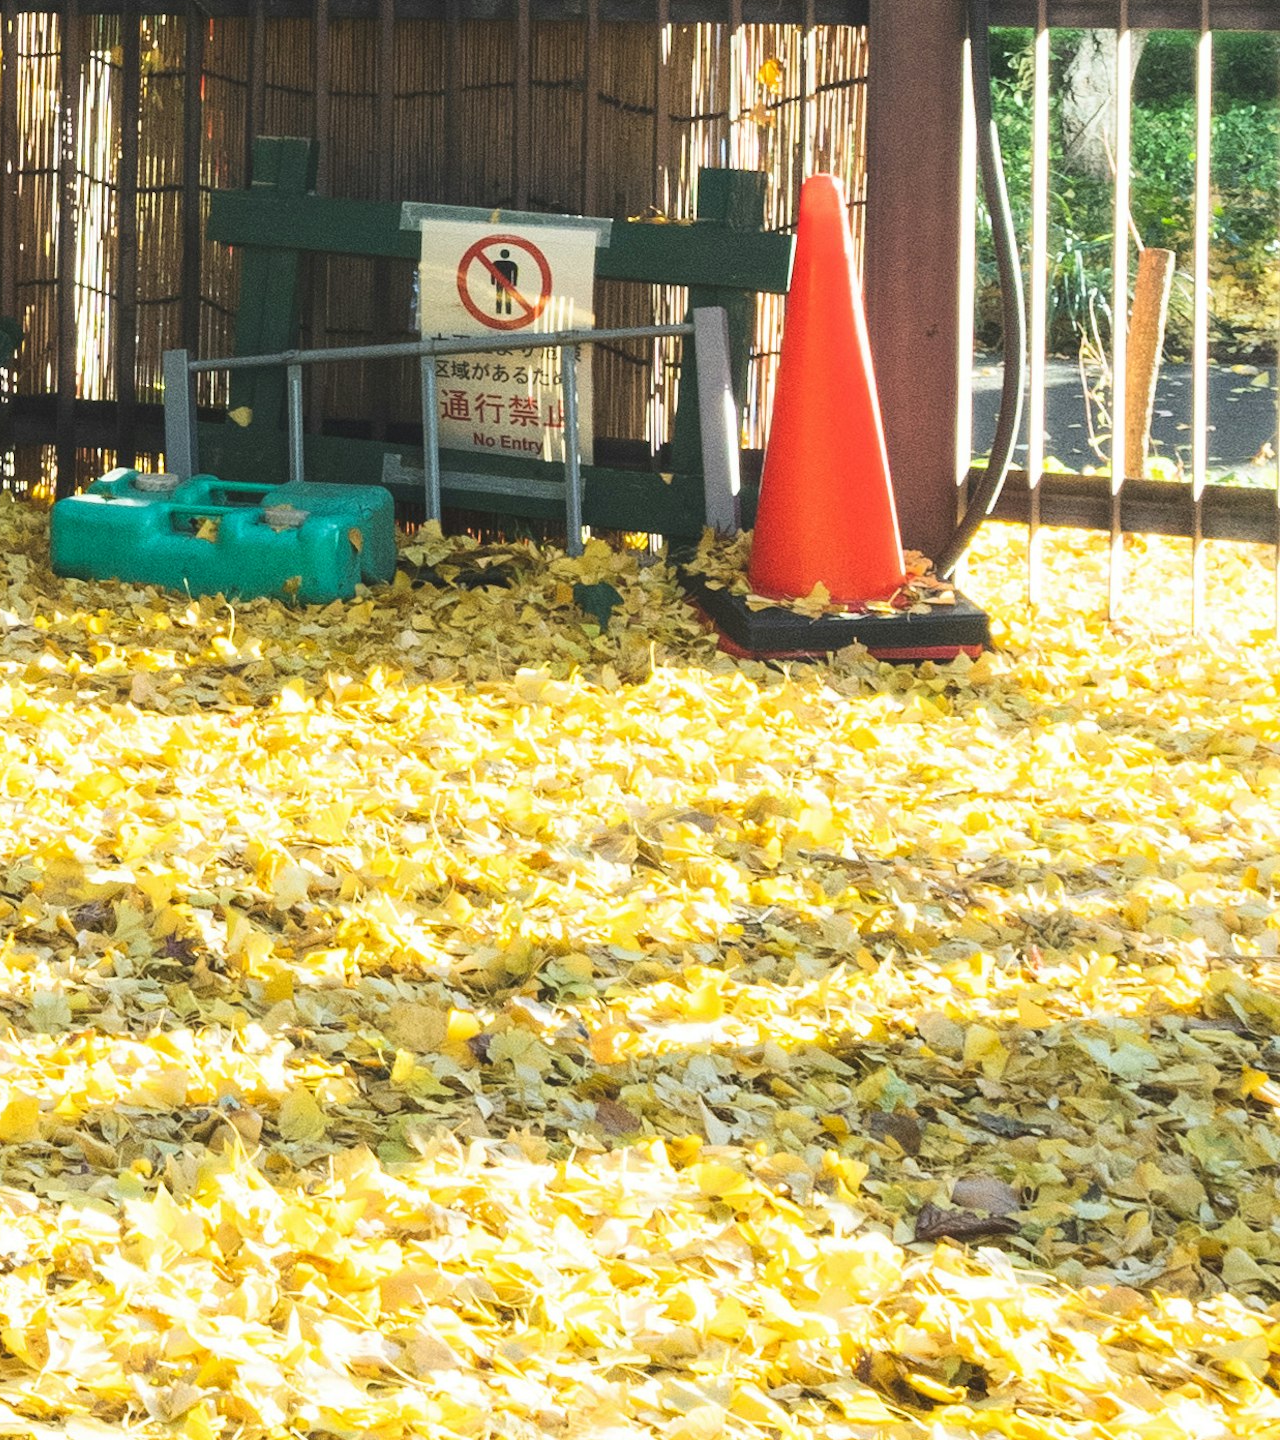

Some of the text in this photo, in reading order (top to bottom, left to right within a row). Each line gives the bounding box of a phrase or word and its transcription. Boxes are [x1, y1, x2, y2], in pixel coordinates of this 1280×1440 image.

[440, 390, 565, 428] 通行禁止
[473, 433, 544, 455] No Entry
